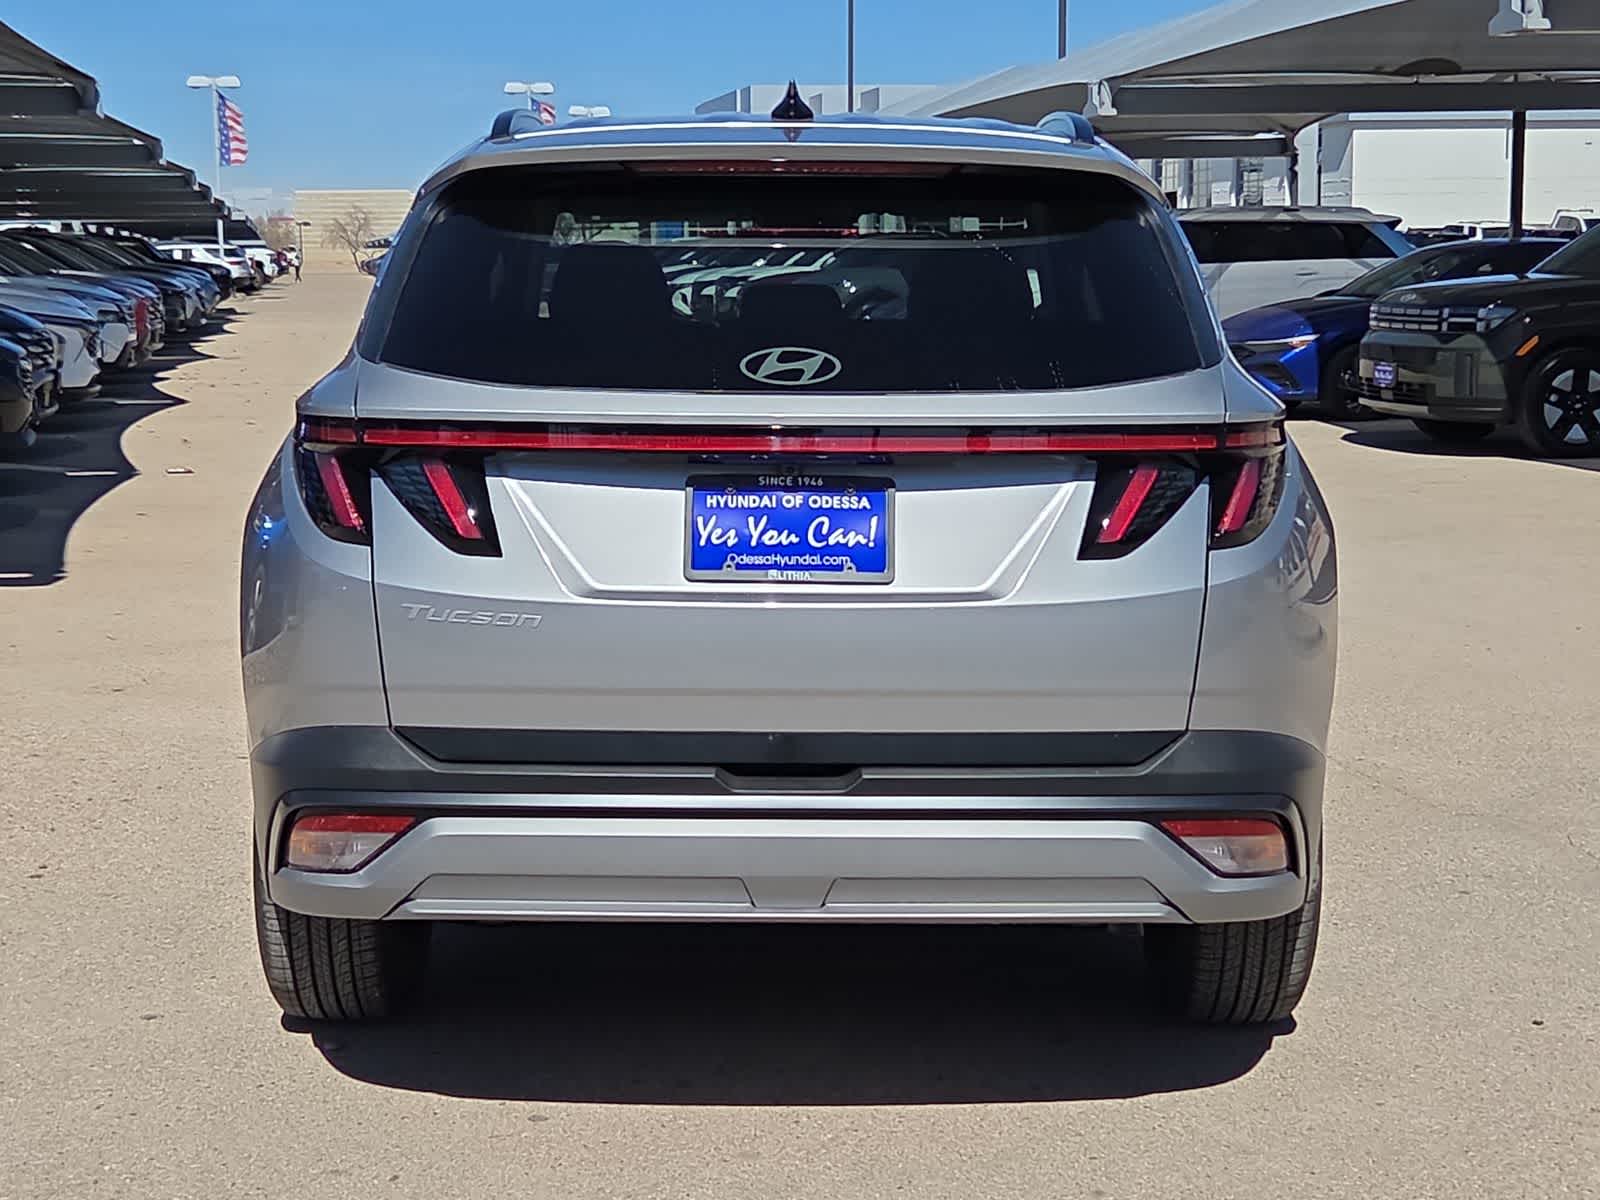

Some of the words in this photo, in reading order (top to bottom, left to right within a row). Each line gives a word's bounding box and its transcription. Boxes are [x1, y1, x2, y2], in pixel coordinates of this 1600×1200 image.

[758, 476, 793, 486] SINCE
[797, 476, 824, 486] 1946
[706, 495, 777, 509] HYUNDAI
[782, 495, 803, 509] OF
[808, 495, 871, 509] ODESSA
[696, 515, 738, 547] Yes
[747, 515, 799, 547] You
[807, 515, 879, 548] Can!
[727, 553, 851, 566] OdessaHyundai.com
